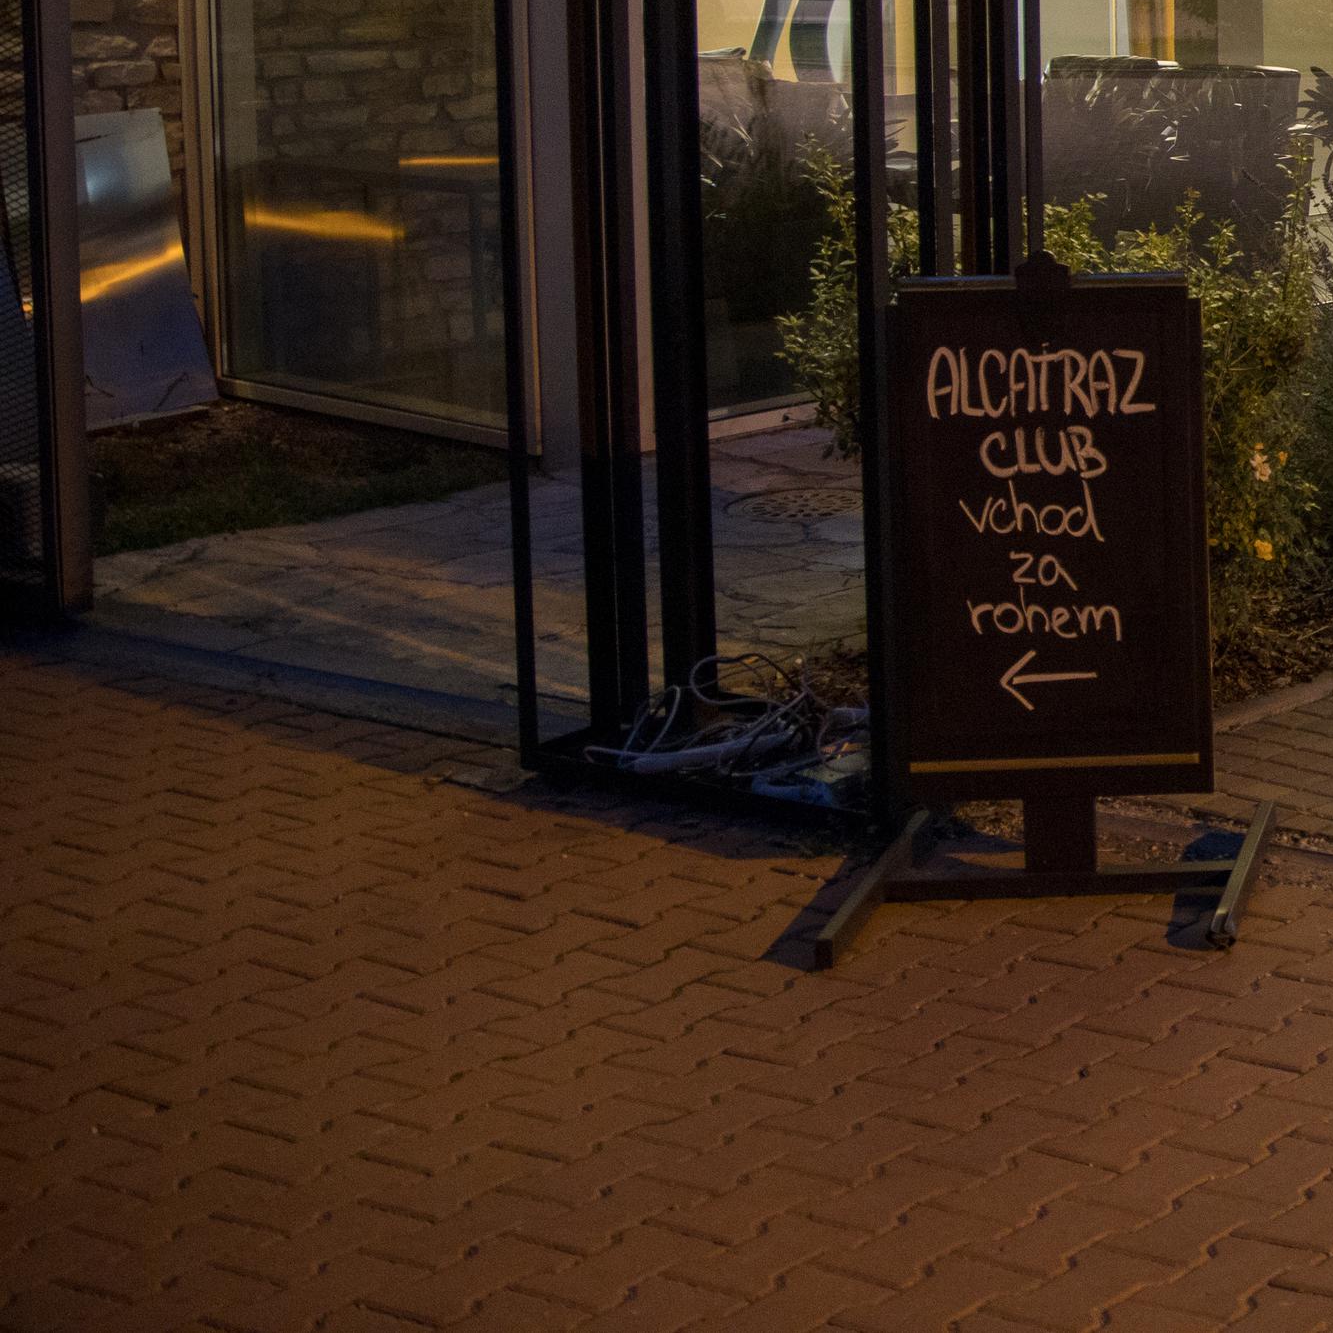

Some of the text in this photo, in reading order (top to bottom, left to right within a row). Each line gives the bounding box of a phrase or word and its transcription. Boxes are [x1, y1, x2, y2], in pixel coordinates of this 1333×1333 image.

[926, 343, 1157, 420] ALCATRAZ
[980, 425, 1108, 479] CLUB
[958, 480, 1106, 543] vchod
[1009, 551, 1078, 591] za
[966, 585, 1123, 642] rohem
